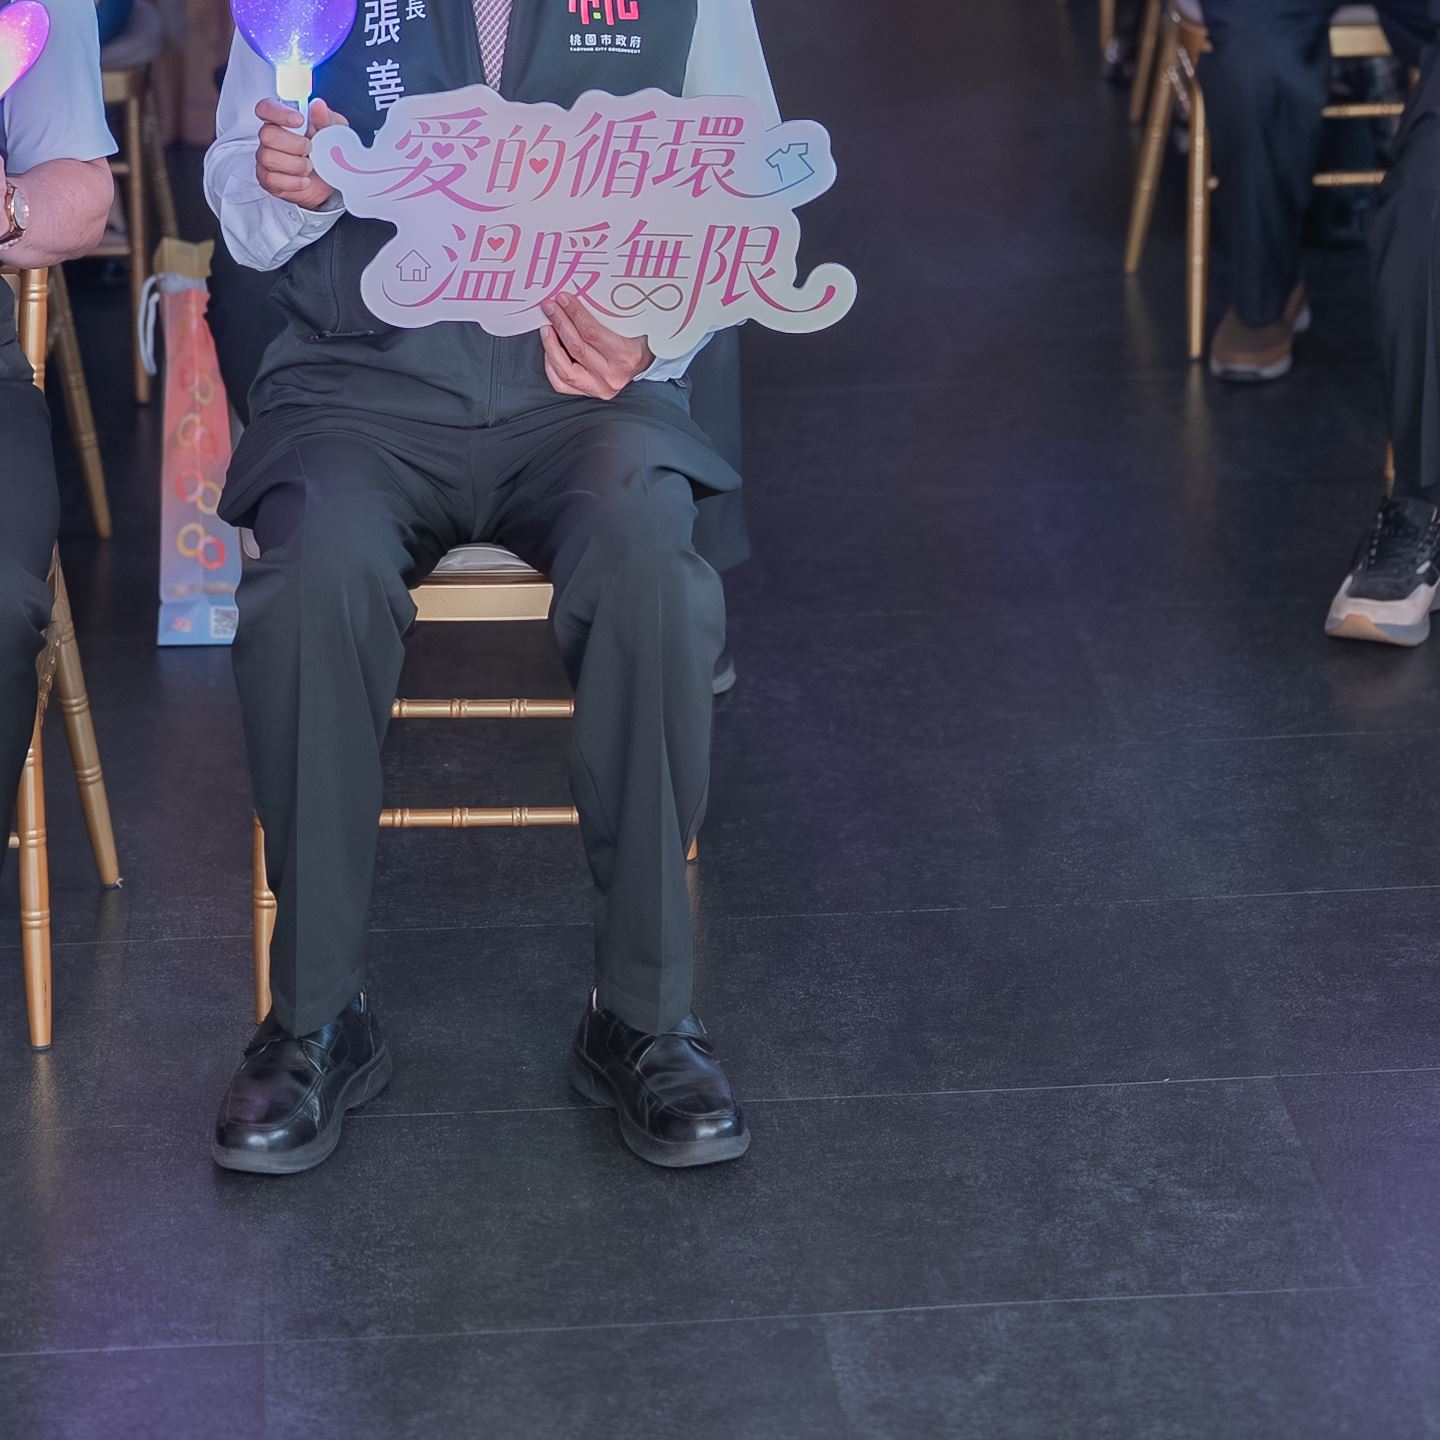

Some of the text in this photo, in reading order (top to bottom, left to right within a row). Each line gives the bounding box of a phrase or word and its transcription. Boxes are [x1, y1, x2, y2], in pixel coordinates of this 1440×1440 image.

[569, 33, 641, 48] 桃園市政府
[330, 106, 750, 212] 愛的循環
[383, 218, 836, 340] 溫暖無限
